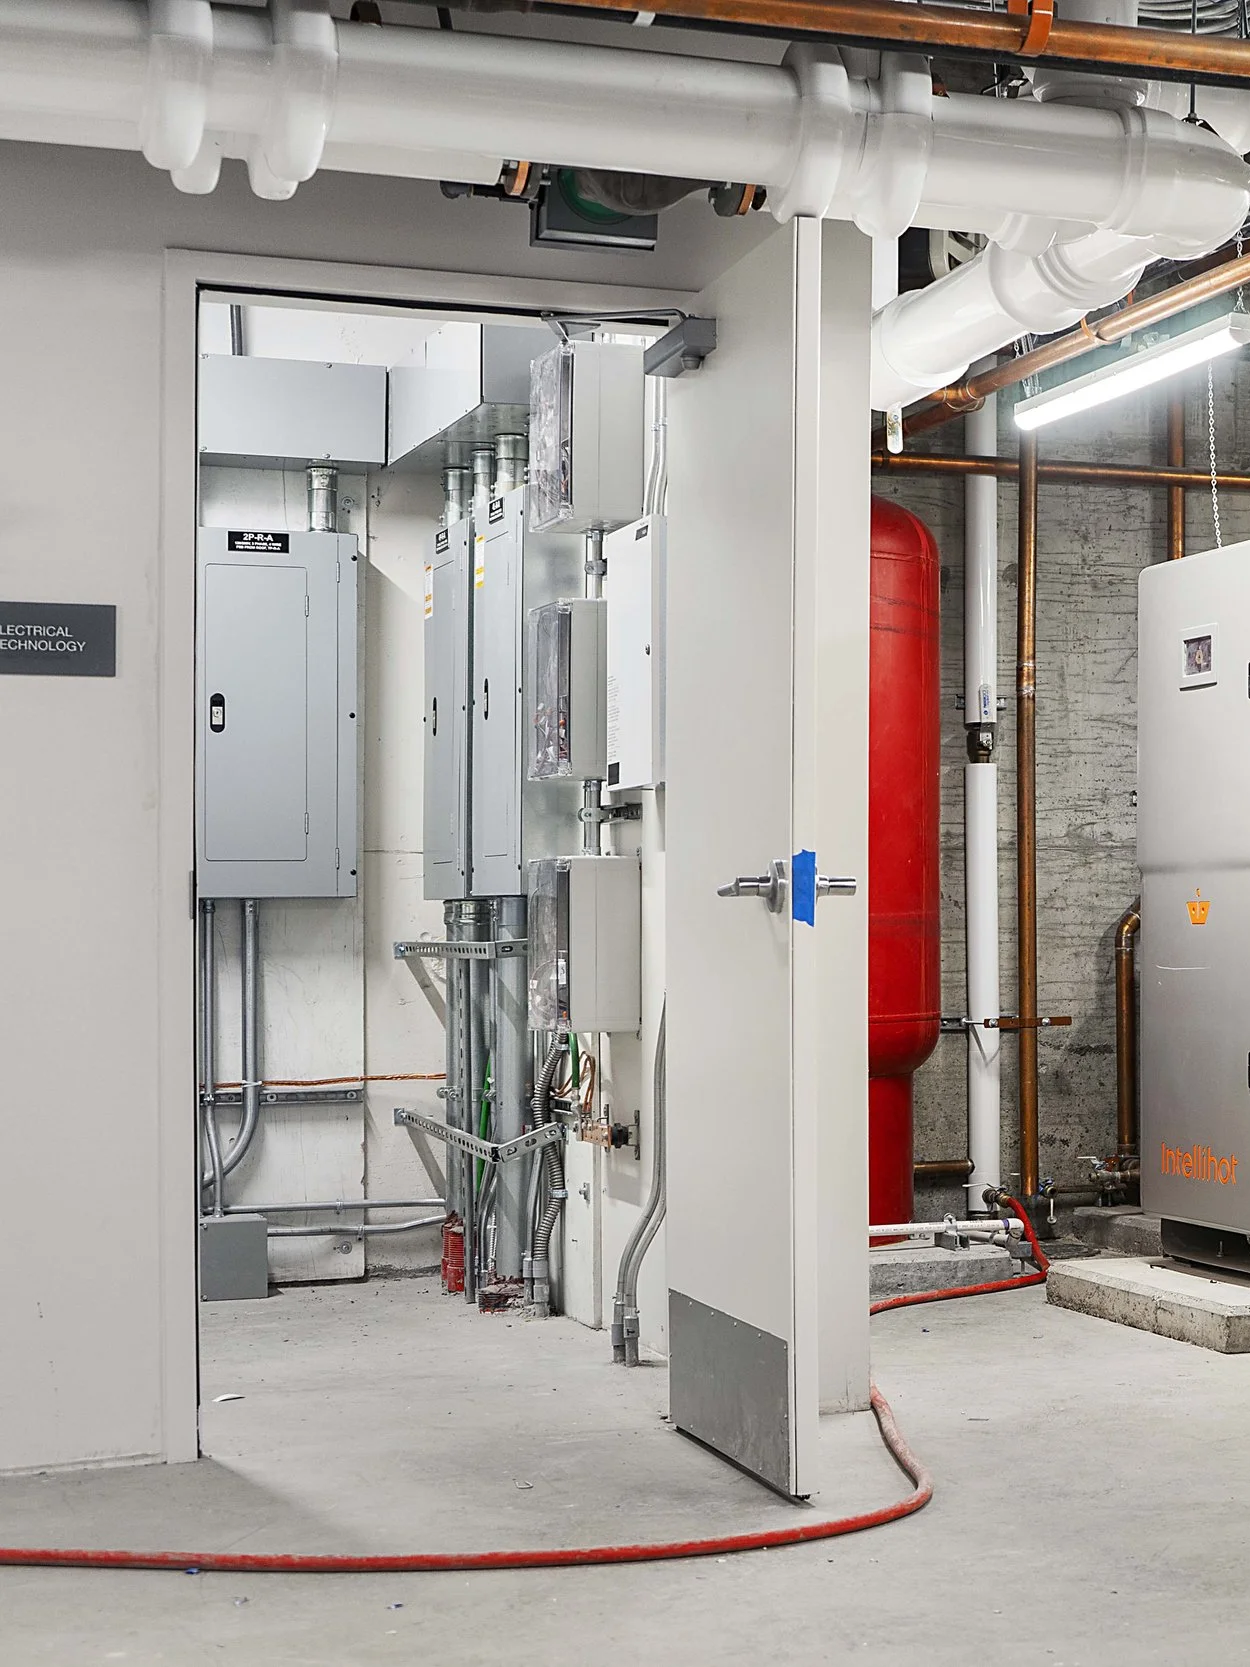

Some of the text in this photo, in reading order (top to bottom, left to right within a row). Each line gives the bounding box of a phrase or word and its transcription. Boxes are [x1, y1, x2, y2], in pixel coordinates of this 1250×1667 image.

[243, 533, 273, 541] 2P-R-A
[0, 625, 73, 637] LECTRICAL
[0, 639, 86, 652] ECHNOLOGY
[1161, 1141, 1238, 1185] Intellihot
